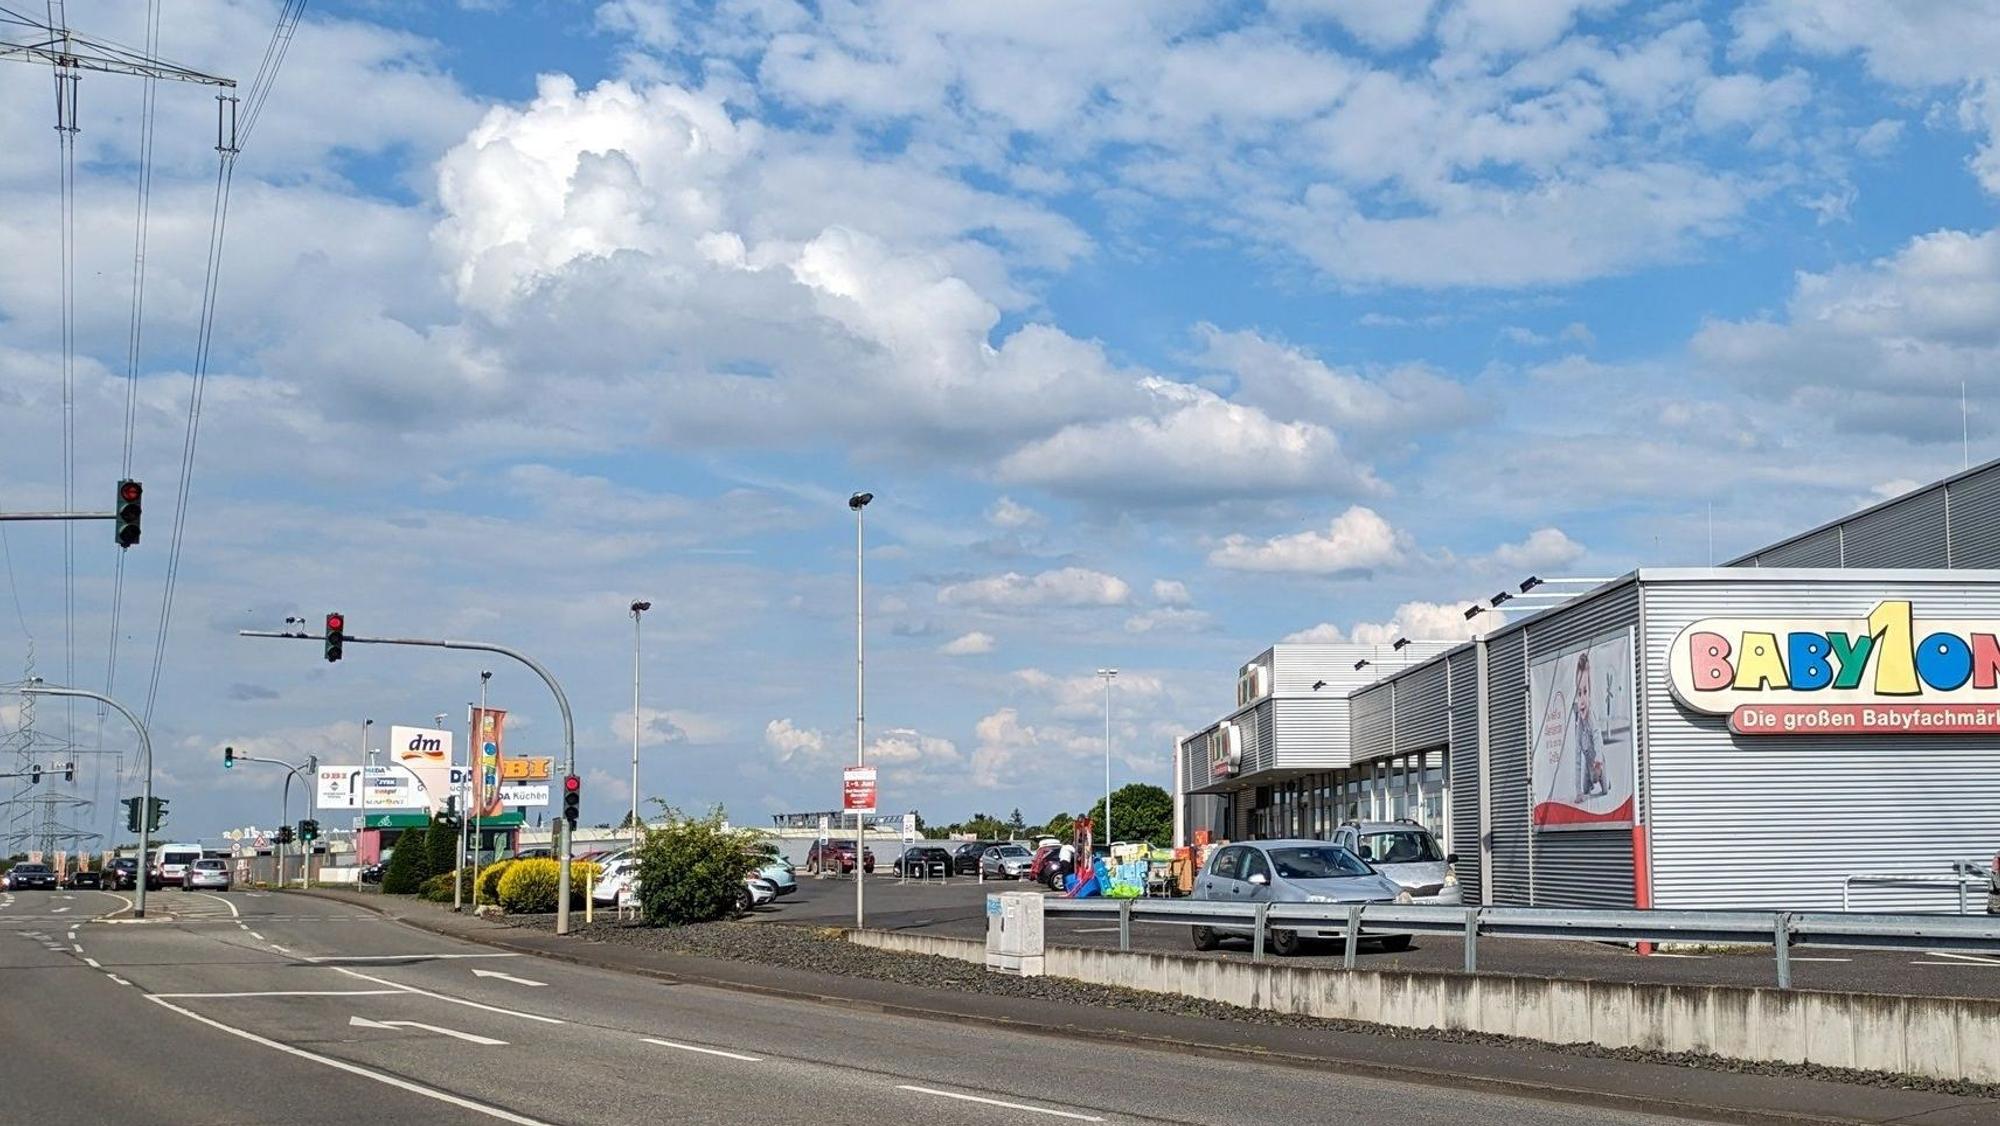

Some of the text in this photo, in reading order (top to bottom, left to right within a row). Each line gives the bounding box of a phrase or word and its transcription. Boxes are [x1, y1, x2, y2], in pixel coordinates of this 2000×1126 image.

[1743, 710, 1777, 727] Die
[1784, 709, 1855, 730] großen
[409, 734, 441, 751] dm
[320, 772, 347, 780] OBI
[503, 760, 550, 778] BI
[513, 790, 547, 800] Küchen
